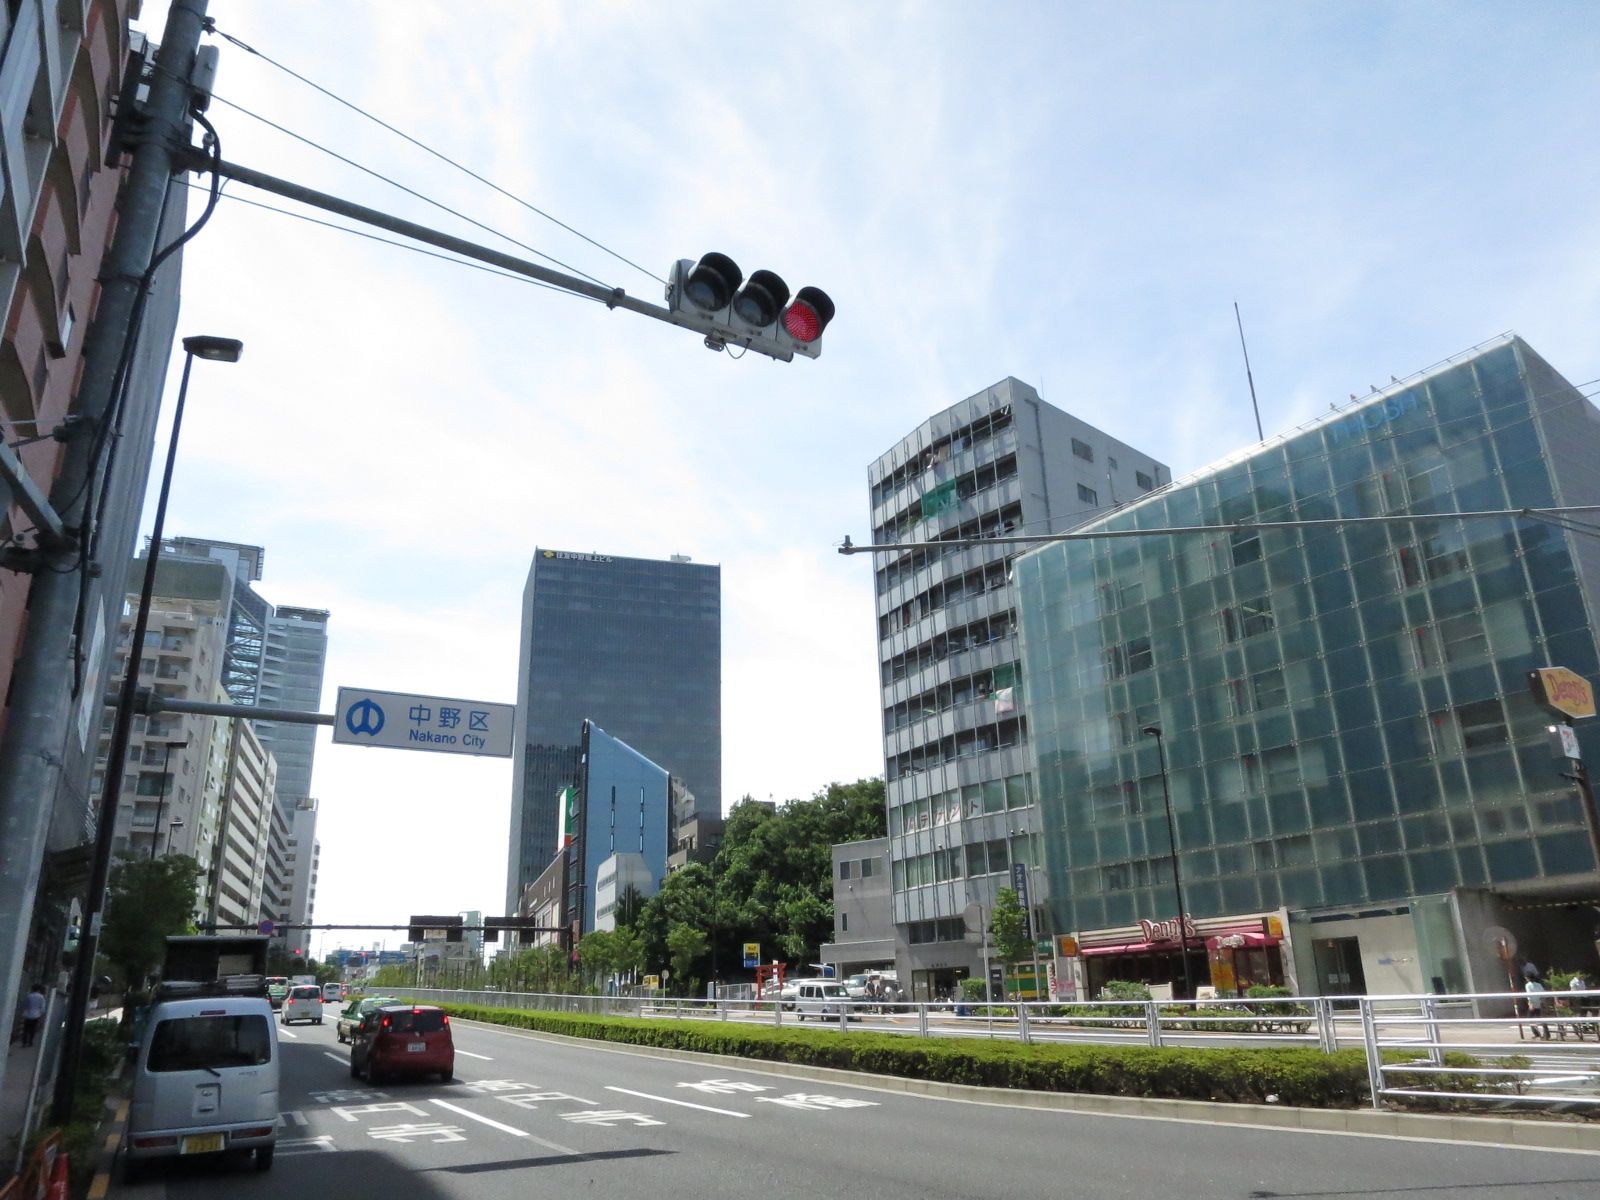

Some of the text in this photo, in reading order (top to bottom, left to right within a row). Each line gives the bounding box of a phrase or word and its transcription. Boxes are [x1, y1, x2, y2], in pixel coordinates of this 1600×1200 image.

[409, 704, 490, 732] 中野区
[409, 729, 486, 749] Nakano City
[1138, 912, 1196, 944] Denny's
